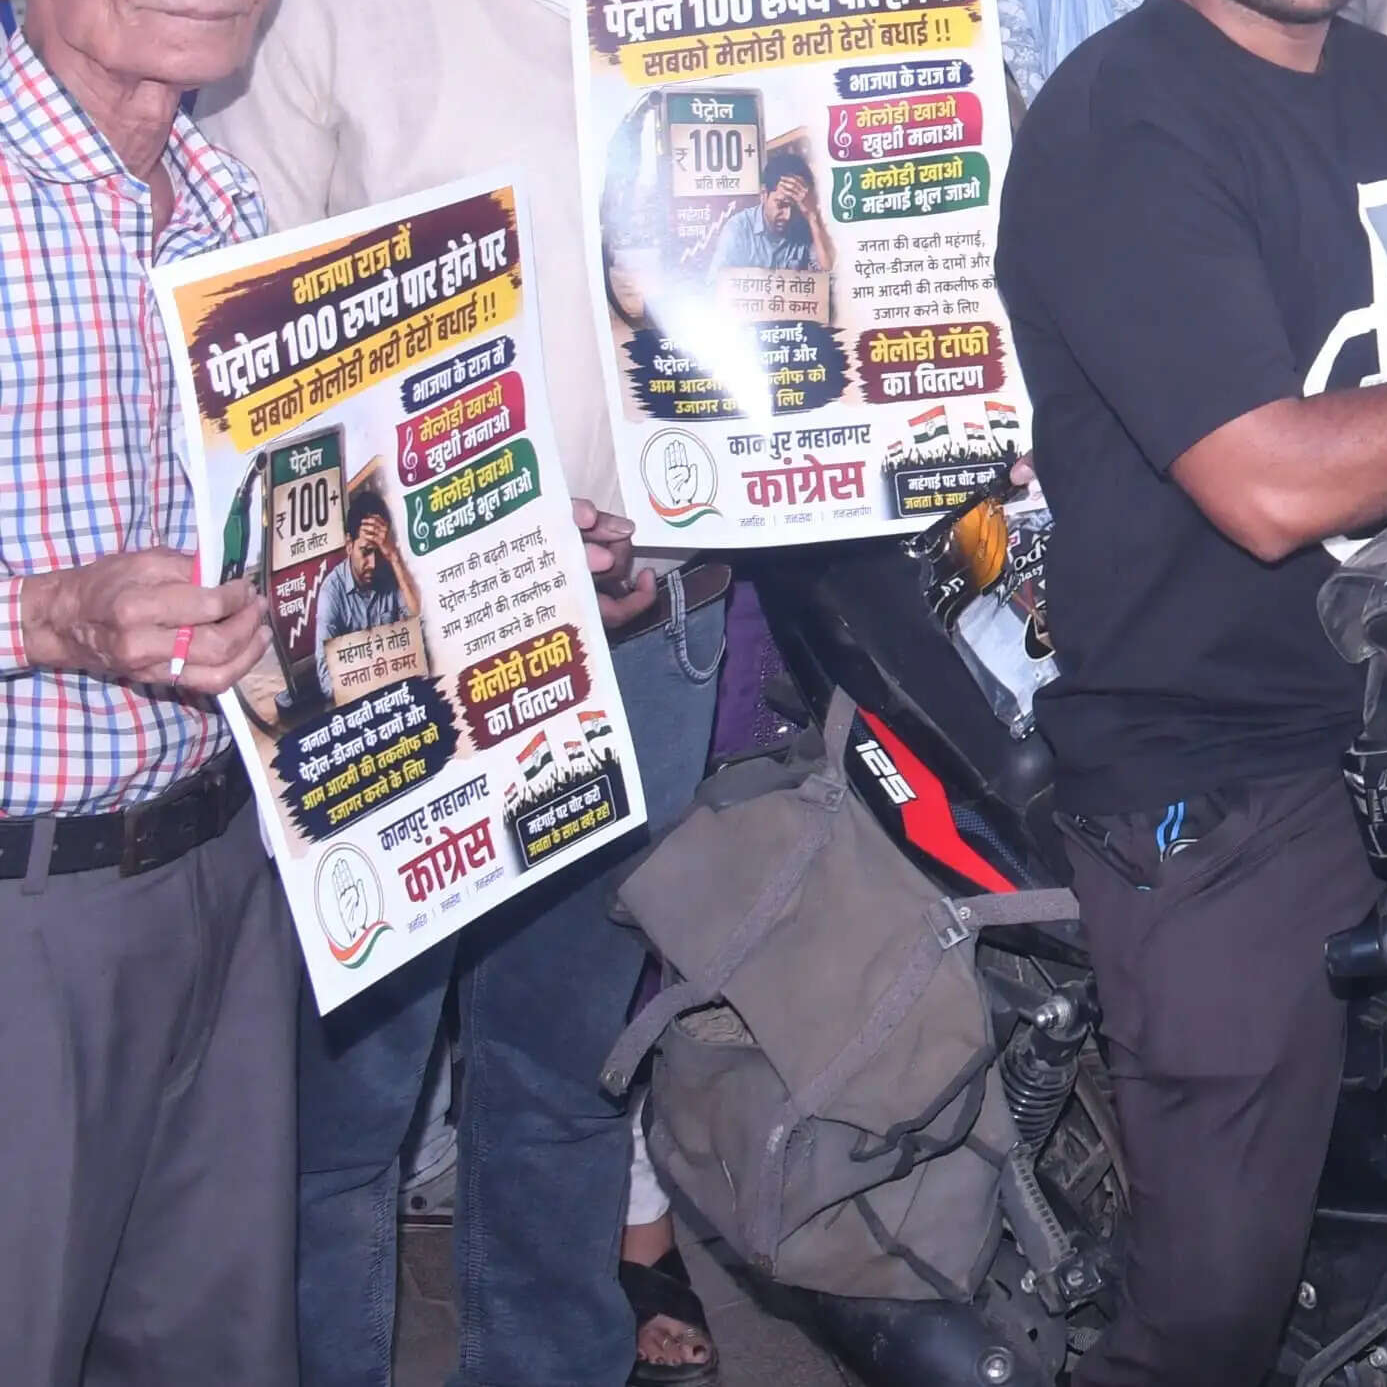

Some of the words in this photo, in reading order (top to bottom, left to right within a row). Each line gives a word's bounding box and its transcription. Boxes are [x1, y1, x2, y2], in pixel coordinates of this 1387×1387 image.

[642, 36, 709, 76] सबको
[715, 28, 785, 67] मेलोडी
[792, 23, 833, 55] भरी
[838, 19, 878, 52] ढेरों
[881, 13, 928, 46] बधाई
[934, 18, 951, 43] !!
[292, 255, 354, 303] भाजपा
[353, 241, 391, 278] राज
[390, 222, 412, 261] में
[206, 331, 279, 396] पेट्रोल
[281, 305, 337, 365] 100
[339, 270, 398, 338] रुपये
[400, 259, 437, 307] पार
[438, 233, 477, 296] होने
[477, 228, 507, 271] पर
[247, 379, 304, 436] सबको
[306, 347, 364, 405] मेलोडी
[368, 330, 402, 375] भरी
[403, 312, 439, 358] ढेरों
[435, 292, 477, 341] बधाई
[482, 290, 497, 322] !!
[412, 367, 452, 402] भाजपा
[451, 358, 466, 383] के
[466, 349, 491, 378] राज
[490, 338, 506, 365] में
[418, 399, 464, 441] मेलोडी
[464, 381, 502, 419] खाओ
[424, 429, 461, 472] खुशी
[461, 405, 510, 448] मनाओ
[288, 445, 323, 475] पेट्रोल
[427, 468, 475, 512] मेलोडी
[475, 448, 514, 488] खाओ
[432, 496, 476, 538] महंगाई
[475, 487, 500, 520] भूल
[499, 467, 533, 501] जाओ
[289, 536, 306, 557] प्रति
[306, 531, 328, 551] लीटर
[335, 635, 373, 663] महंगाई
[373, 633, 385, 652] ने
[338, 665, 371, 687] जनता
[371, 657, 389, 678] की
[389, 651, 417, 672] कमर
[467, 650, 526, 702] मेलोडी
[525, 630, 572, 677] टॉफी
[298, 725, 331, 752] जनता
[328, 713, 346, 736] की
[483, 702, 513, 735] का
[512, 674, 574, 723] वितरण
[298, 736, 365, 782] पेट्रोल-डीजल
[362, 727, 378, 747] के
[376, 711, 404, 740] दामों
[404, 703, 427, 727] और
[301, 785, 325, 810] आम
[325, 762, 360, 797] आदमी
[358, 753, 376, 777] की
[375, 733, 421, 768] तकलीफ
[420, 721, 439, 744] को
[855, 740, 917, 804] 125
[326, 792, 363, 825] उजागर
[361, 774, 390, 803] करने
[387, 769, 403, 788] के
[401, 758, 426, 782] लिए
[376, 806, 429, 851] कानपुर
[426, 773, 489, 822] महानगर
[398, 817, 495, 902] कांग्रेस
